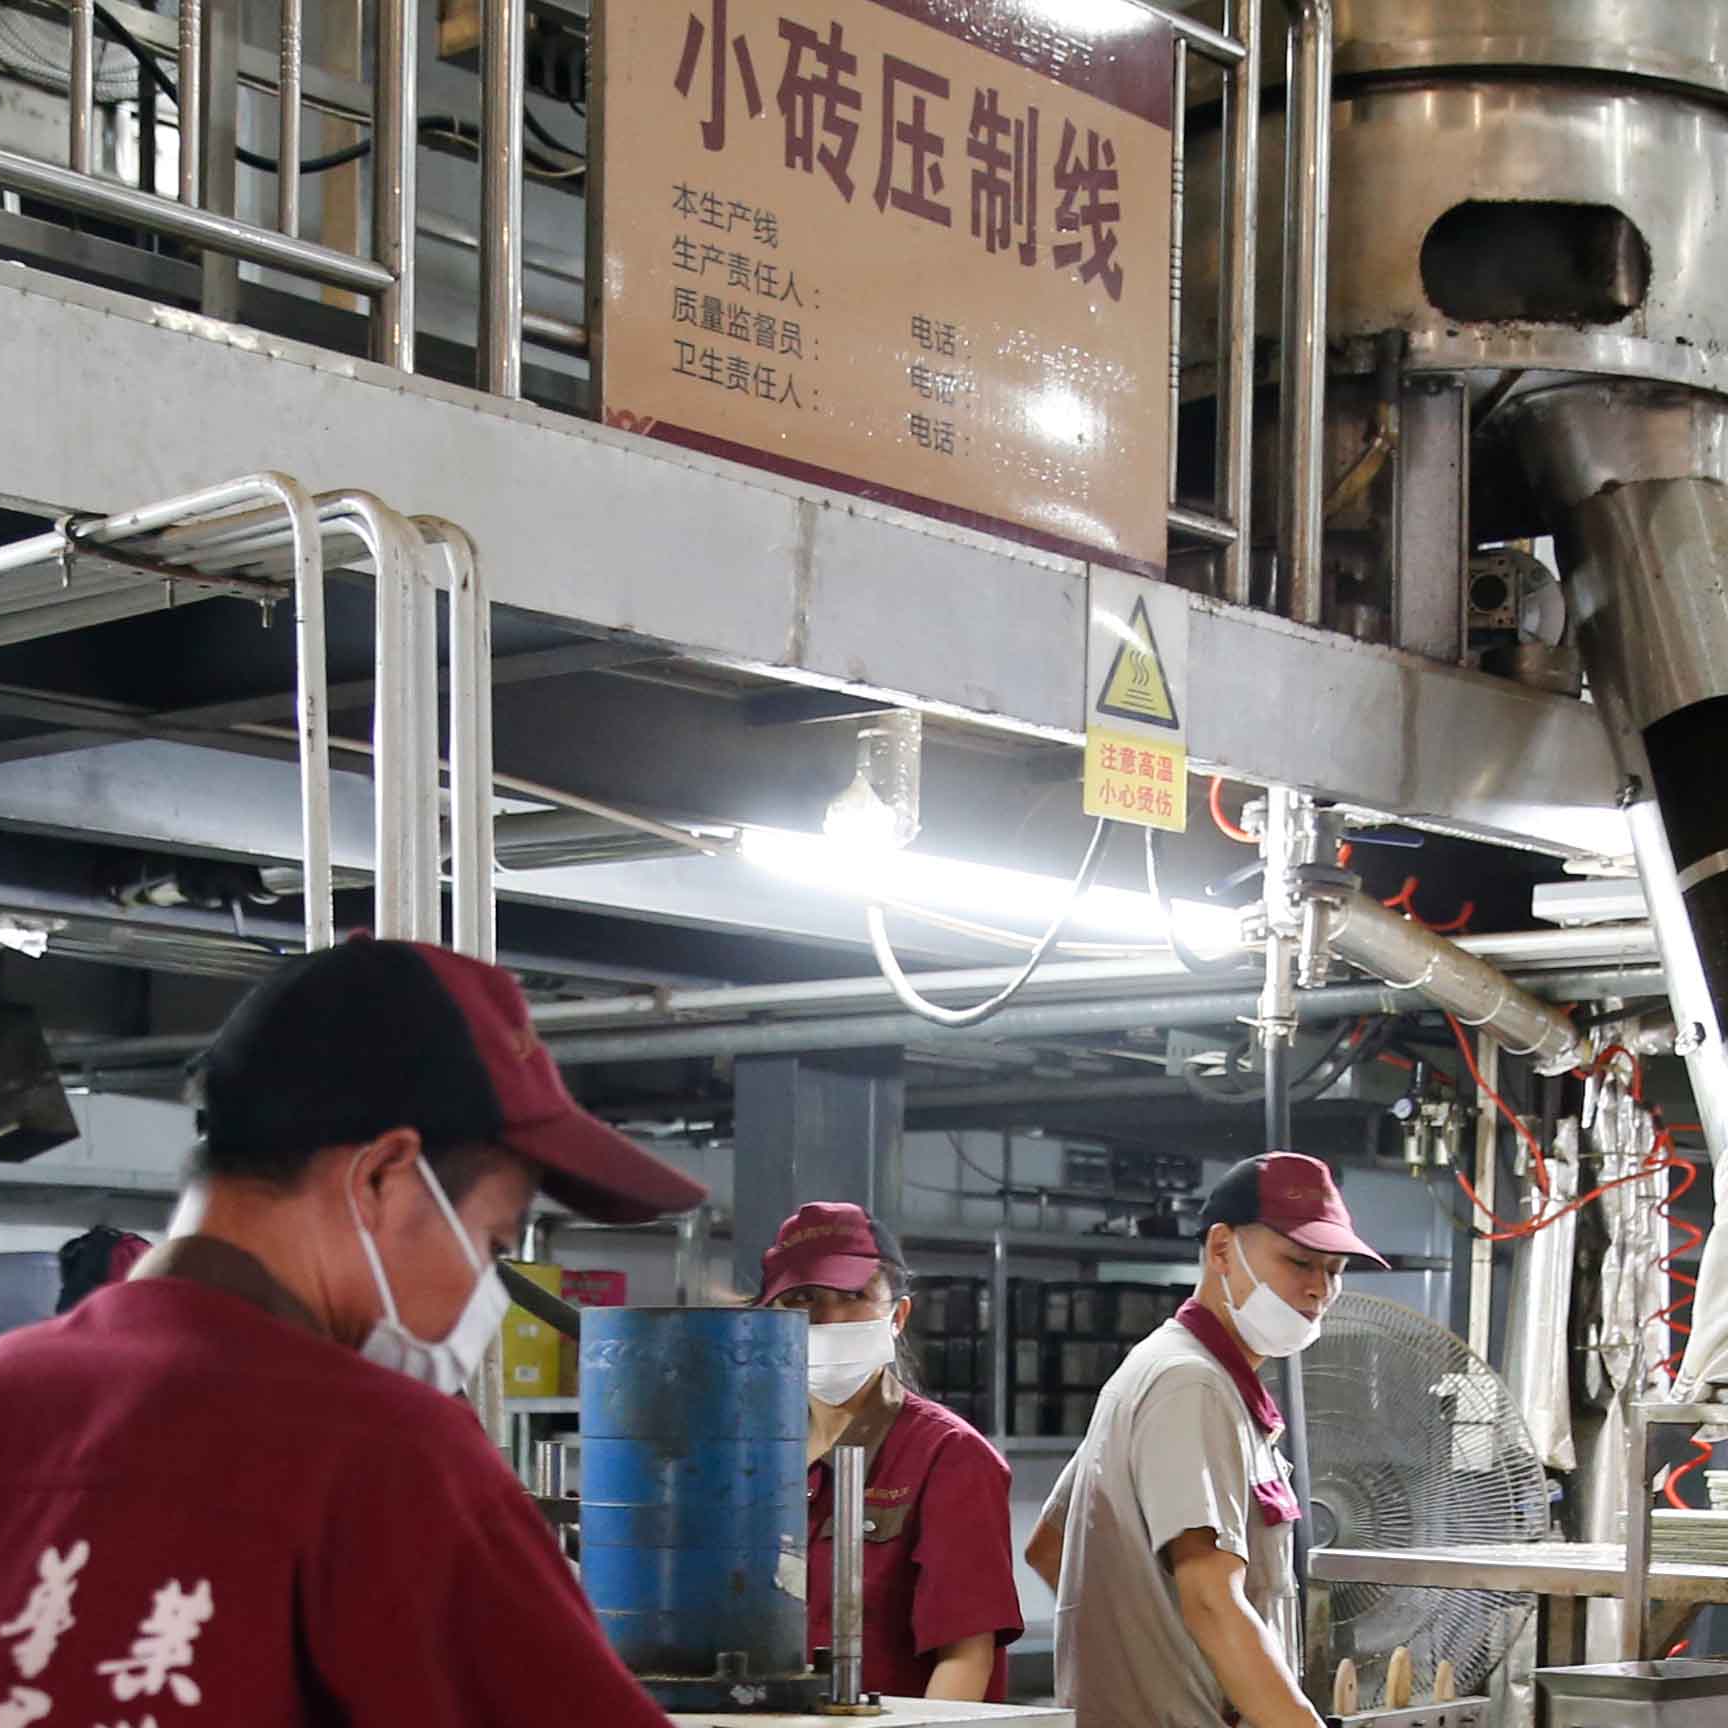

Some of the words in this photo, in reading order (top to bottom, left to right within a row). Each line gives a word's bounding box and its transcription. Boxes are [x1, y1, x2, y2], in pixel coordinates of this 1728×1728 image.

[673, 0, 1124, 302] 小砖压制线
[671, 184, 779, 249] 本生产线
[1099, 743, 1174, 784] 注意高温
[1098, 778, 1173, 817] 小心烫伤
